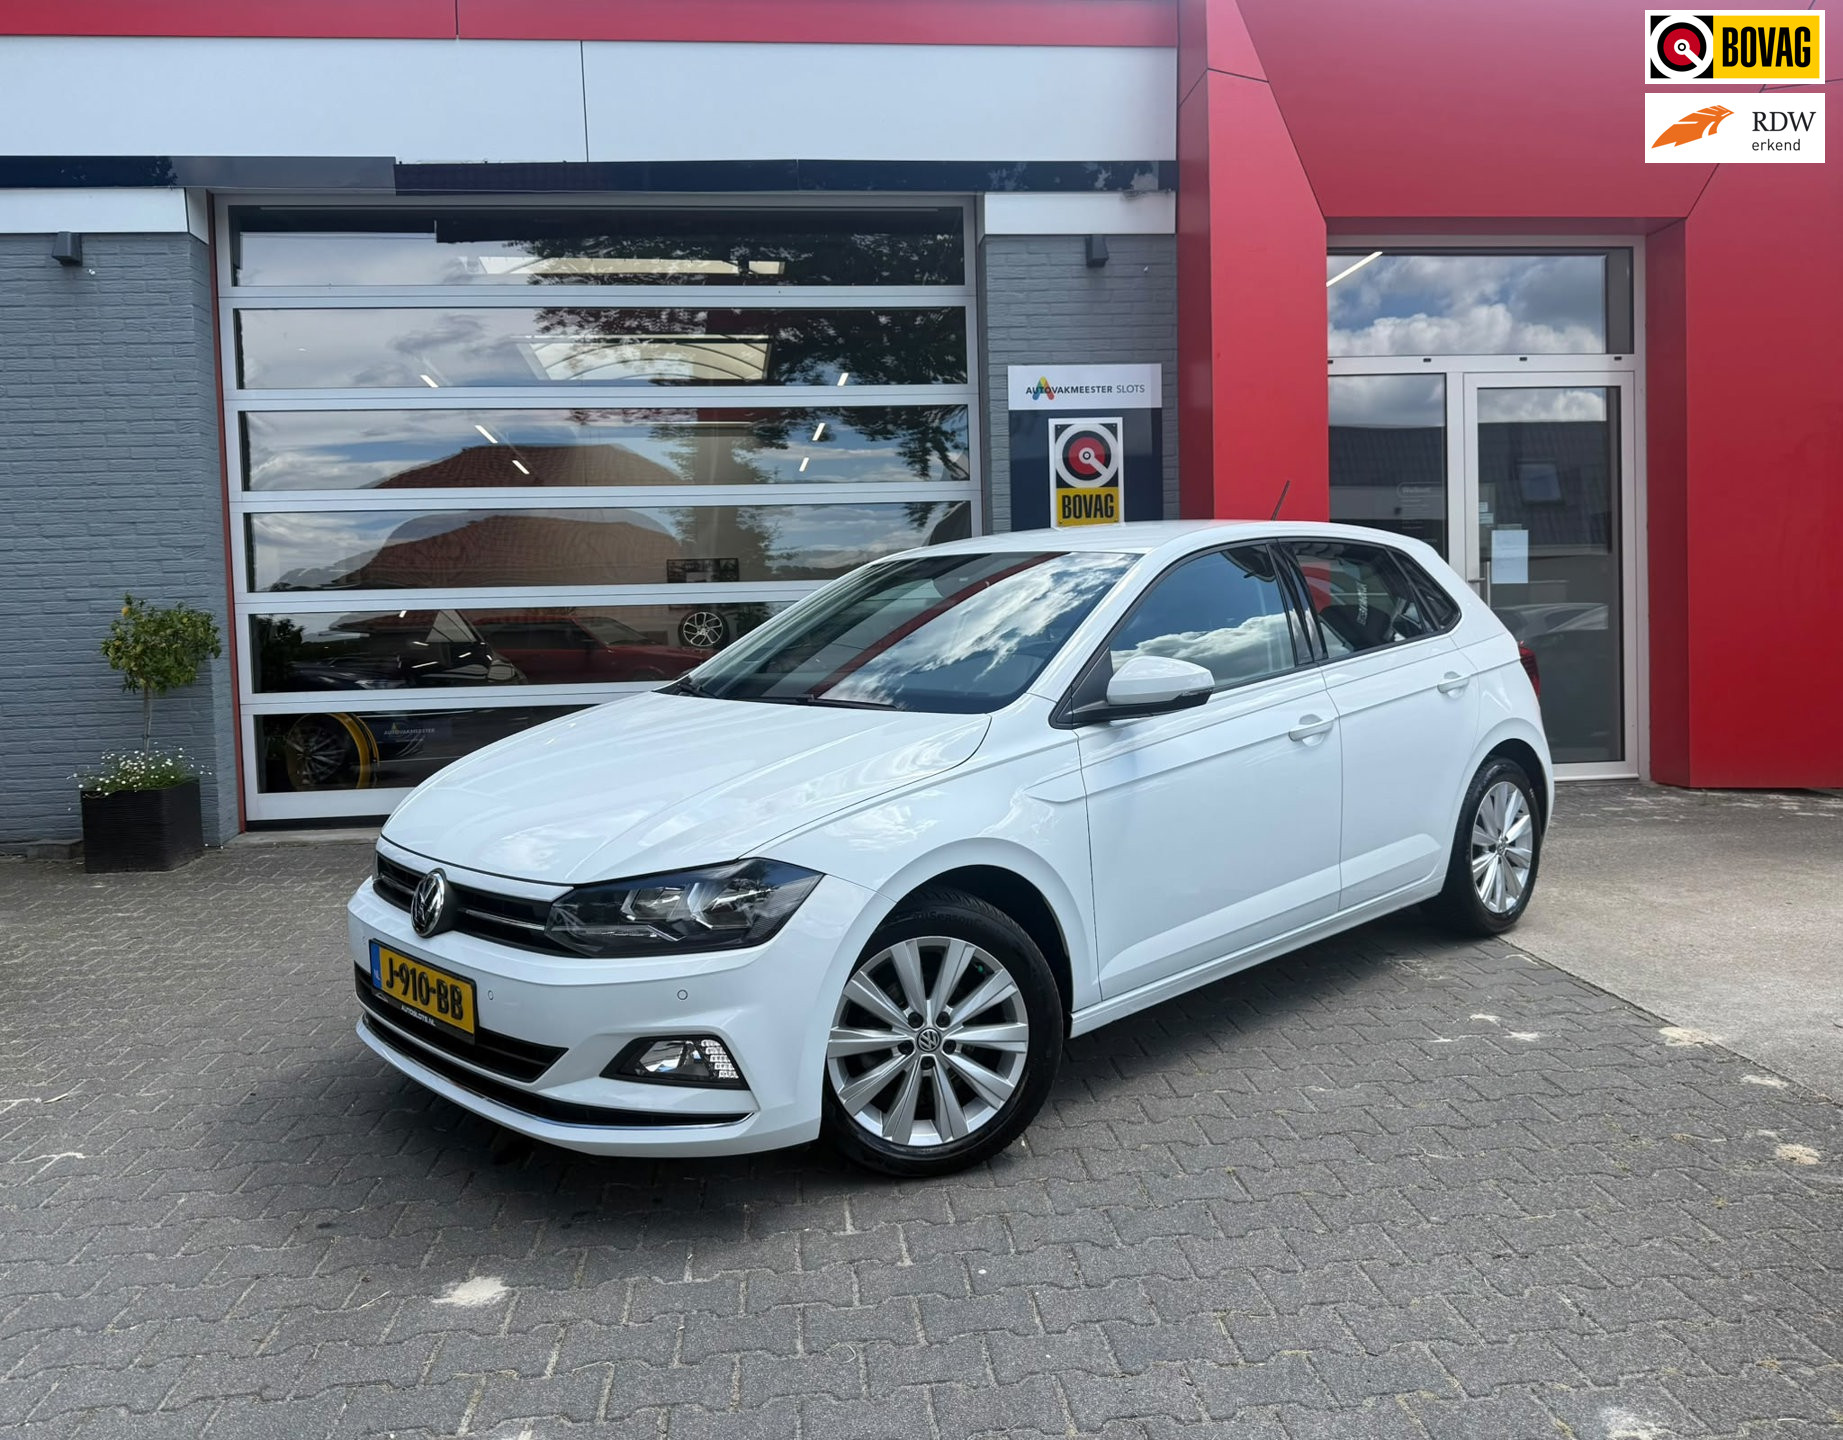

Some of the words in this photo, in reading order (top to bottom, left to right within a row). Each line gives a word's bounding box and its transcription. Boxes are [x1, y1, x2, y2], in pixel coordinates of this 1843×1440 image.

[1025, 385, 1113, 395] AUTOVAKMEESTER
[1116, 384, 1146, 394] SLOTS
[1061, 493, 1115, 519] BOVAG
[386, 957, 464, 1021] J-910-BB
